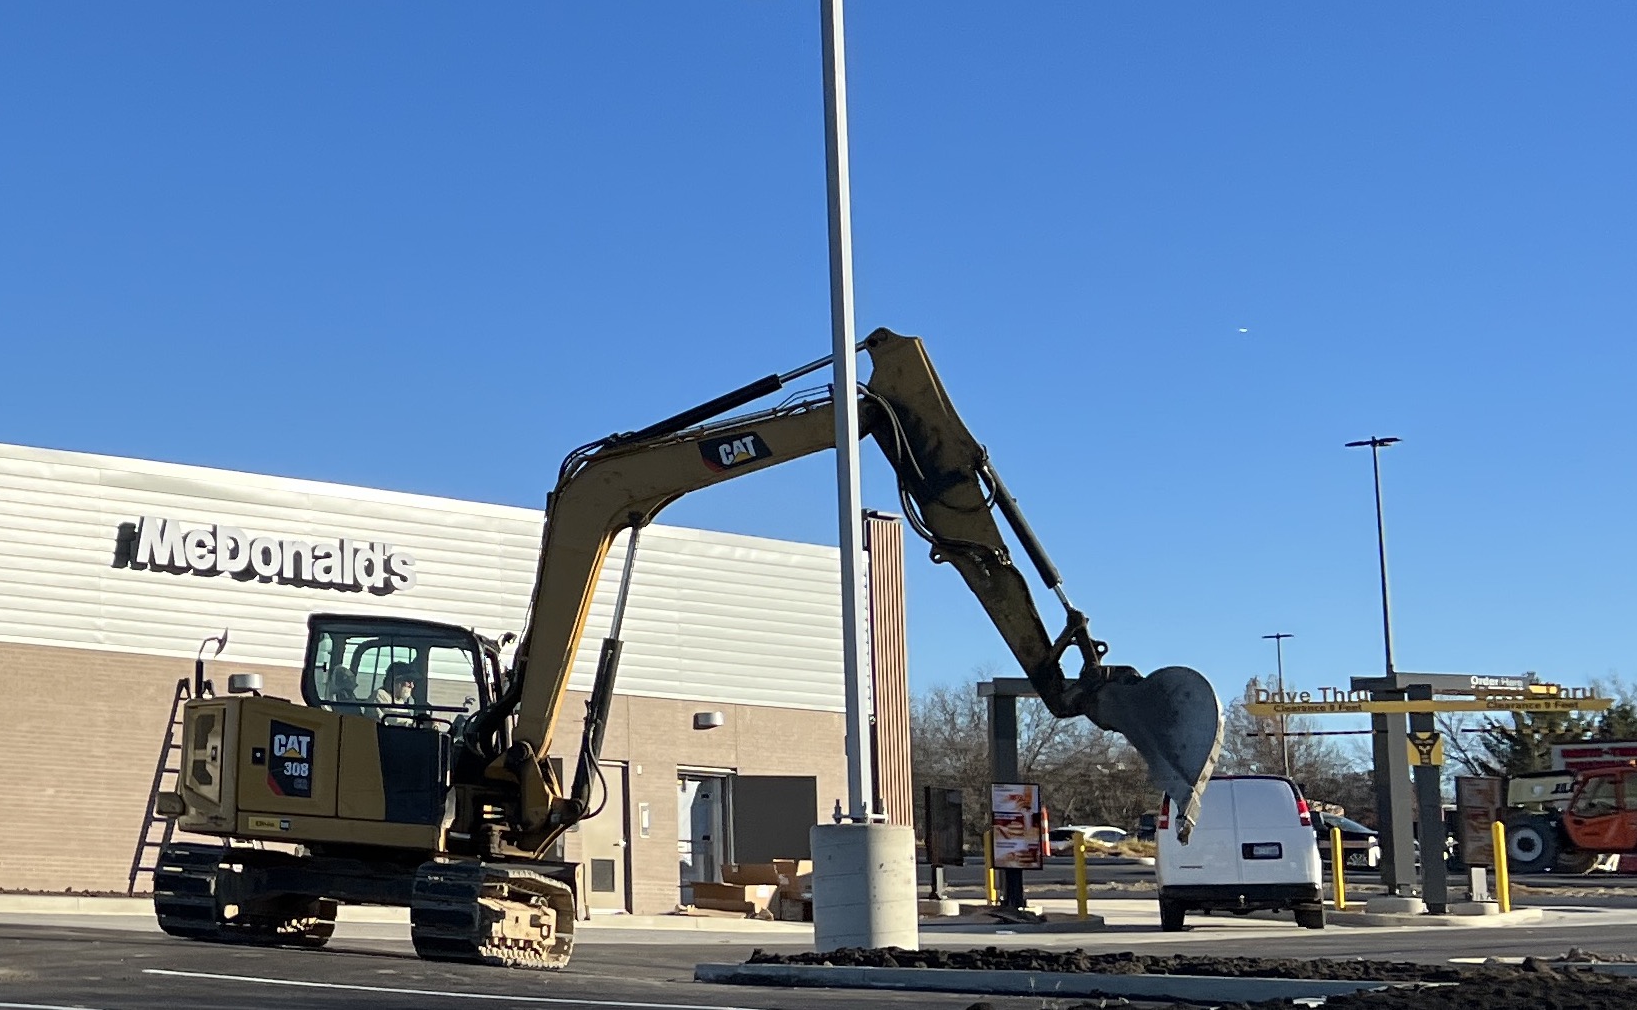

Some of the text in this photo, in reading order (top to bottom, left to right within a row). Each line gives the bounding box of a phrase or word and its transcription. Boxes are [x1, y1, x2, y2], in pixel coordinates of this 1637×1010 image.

[718, 435, 757, 465] CAT
[136, 515, 417, 591] McDonald's
[1470, 675, 1499, 686] Order
[1254, 687, 1369, 704] Drive Thru
[1273, 704, 1326, 712] Clearance
[1486, 701, 1541, 710] Clearance
[273, 734, 311, 759] CAT
[283, 761, 309, 777] 308
